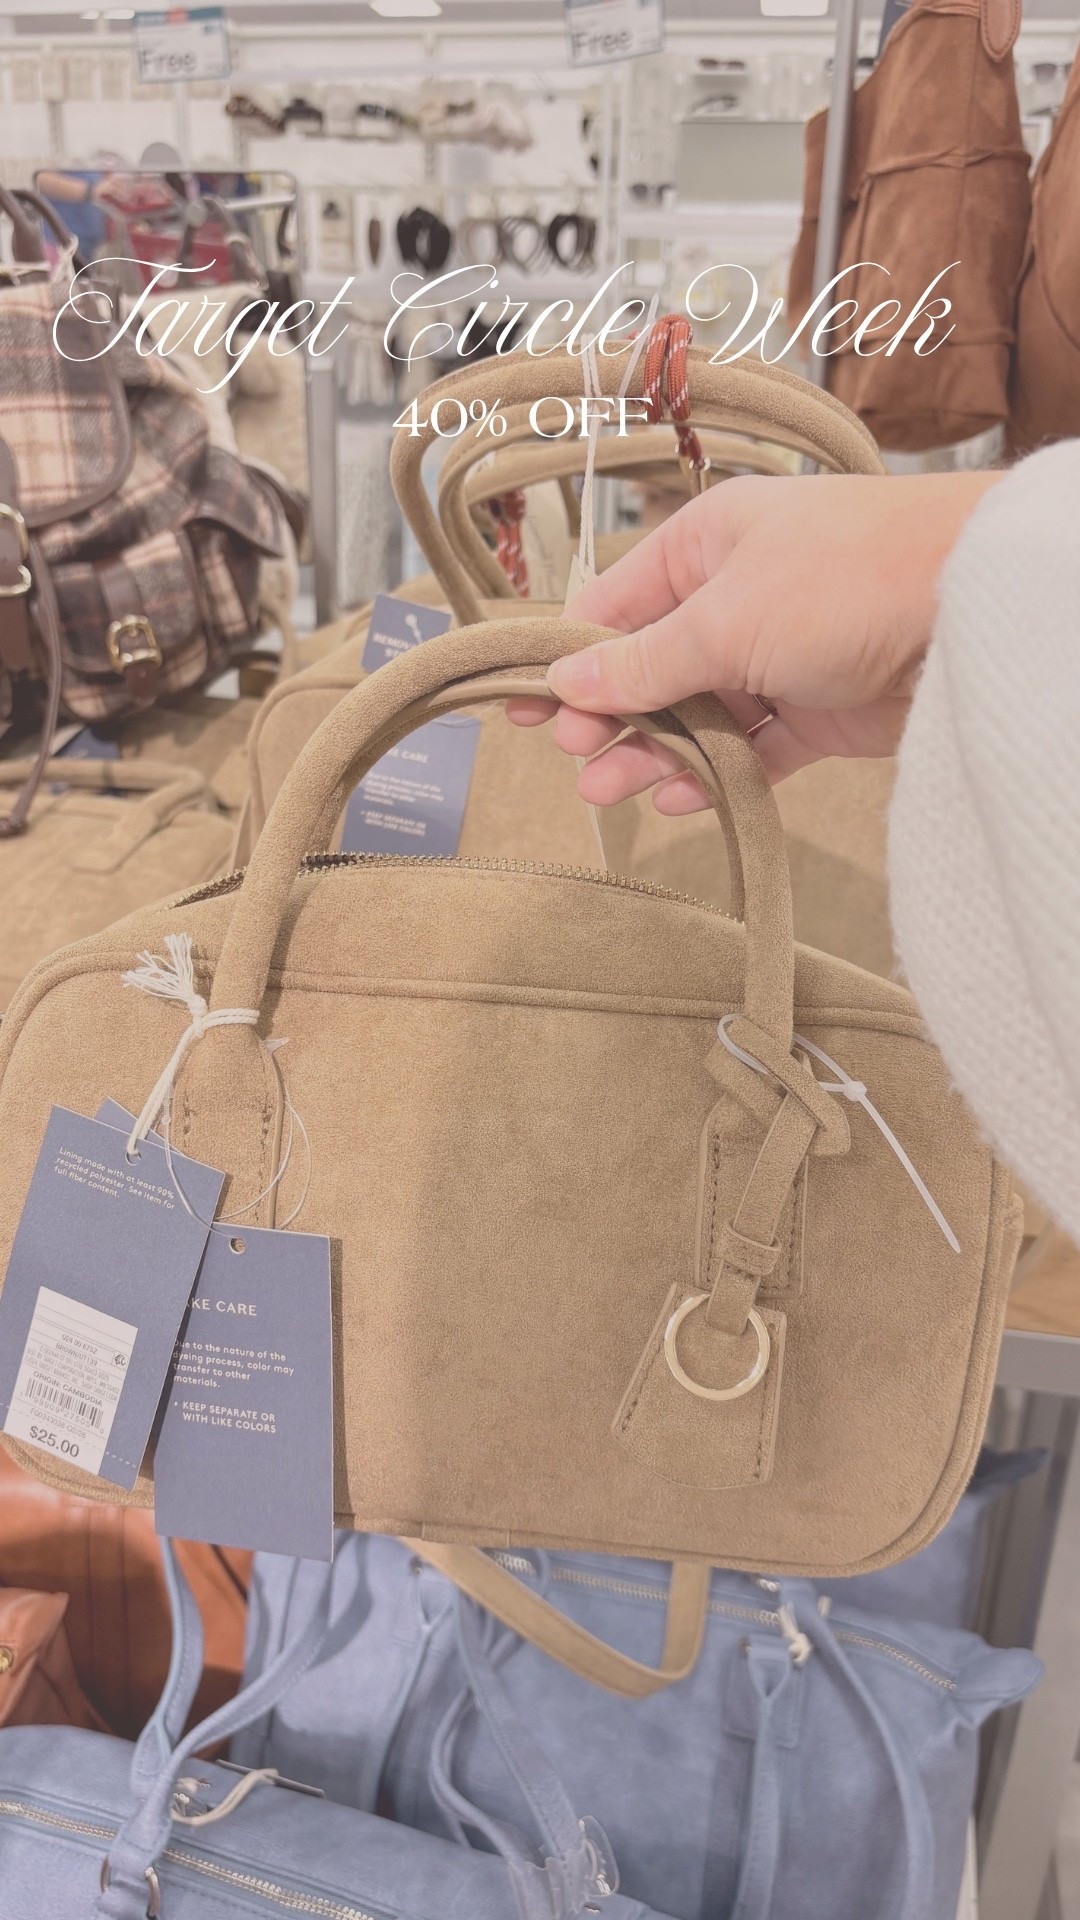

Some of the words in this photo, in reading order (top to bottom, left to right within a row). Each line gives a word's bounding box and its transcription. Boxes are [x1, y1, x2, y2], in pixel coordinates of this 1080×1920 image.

[140, 49, 197, 74] Free
[54, 1165, 68, 1176] full
[69, 1170, 87, 1184] fiber
[88, 1180, 120, 1198] content.
[56, 1158, 88, 1175] recycled
[128, 1185, 142, 1196] See
[144, 1191, 161, 1205] item
[163, 1199, 175, 1210] for
[59, 1147, 83, 1164] Lining
[85, 1159, 106, 1171] made
[108, 1167, 125, 1179] with
[126, 1175, 135, 1183] at
[137, 1178, 155, 1192] least
[157, 1186, 174, 1199] 90%
[188, 1298, 211, 1310] KE
[216, 1300, 257, 1316] CARE
[173, 1351, 203, 1364] dyeing
[206, 1356, 244, 1369] process,
[247, 1362, 271, 1372] color
[274, 1366, 295, 1376] may
[193, 1342, 203, 1350] to
[205, 1343, 221, 1353] the
[223, 1347, 255, 1358] nature
[257, 1350, 268, 1359] of
[270, 1351, 286, 1362] the
[173, 1363, 211, 1375] transfer
[213, 1368, 223, 1377] to
[225, 1370, 251, 1380] other
[173, 1375, 221, 1388] materials.
[33, 1370, 61, 1388] ORIGIN:
[62, 1384, 103, 1408] CAMBODIA
[182, 1401, 207, 1412] KEEP
[209, 1405, 258, 1420] SEPARATE
[261, 1412, 276, 1423] OR
[183, 1412, 208, 1424] WITH
[211, 1416, 233, 1427] LIKE
[235, 1420, 276, 1434] COLORS
[29, 1425, 80, 1458] $25.00
